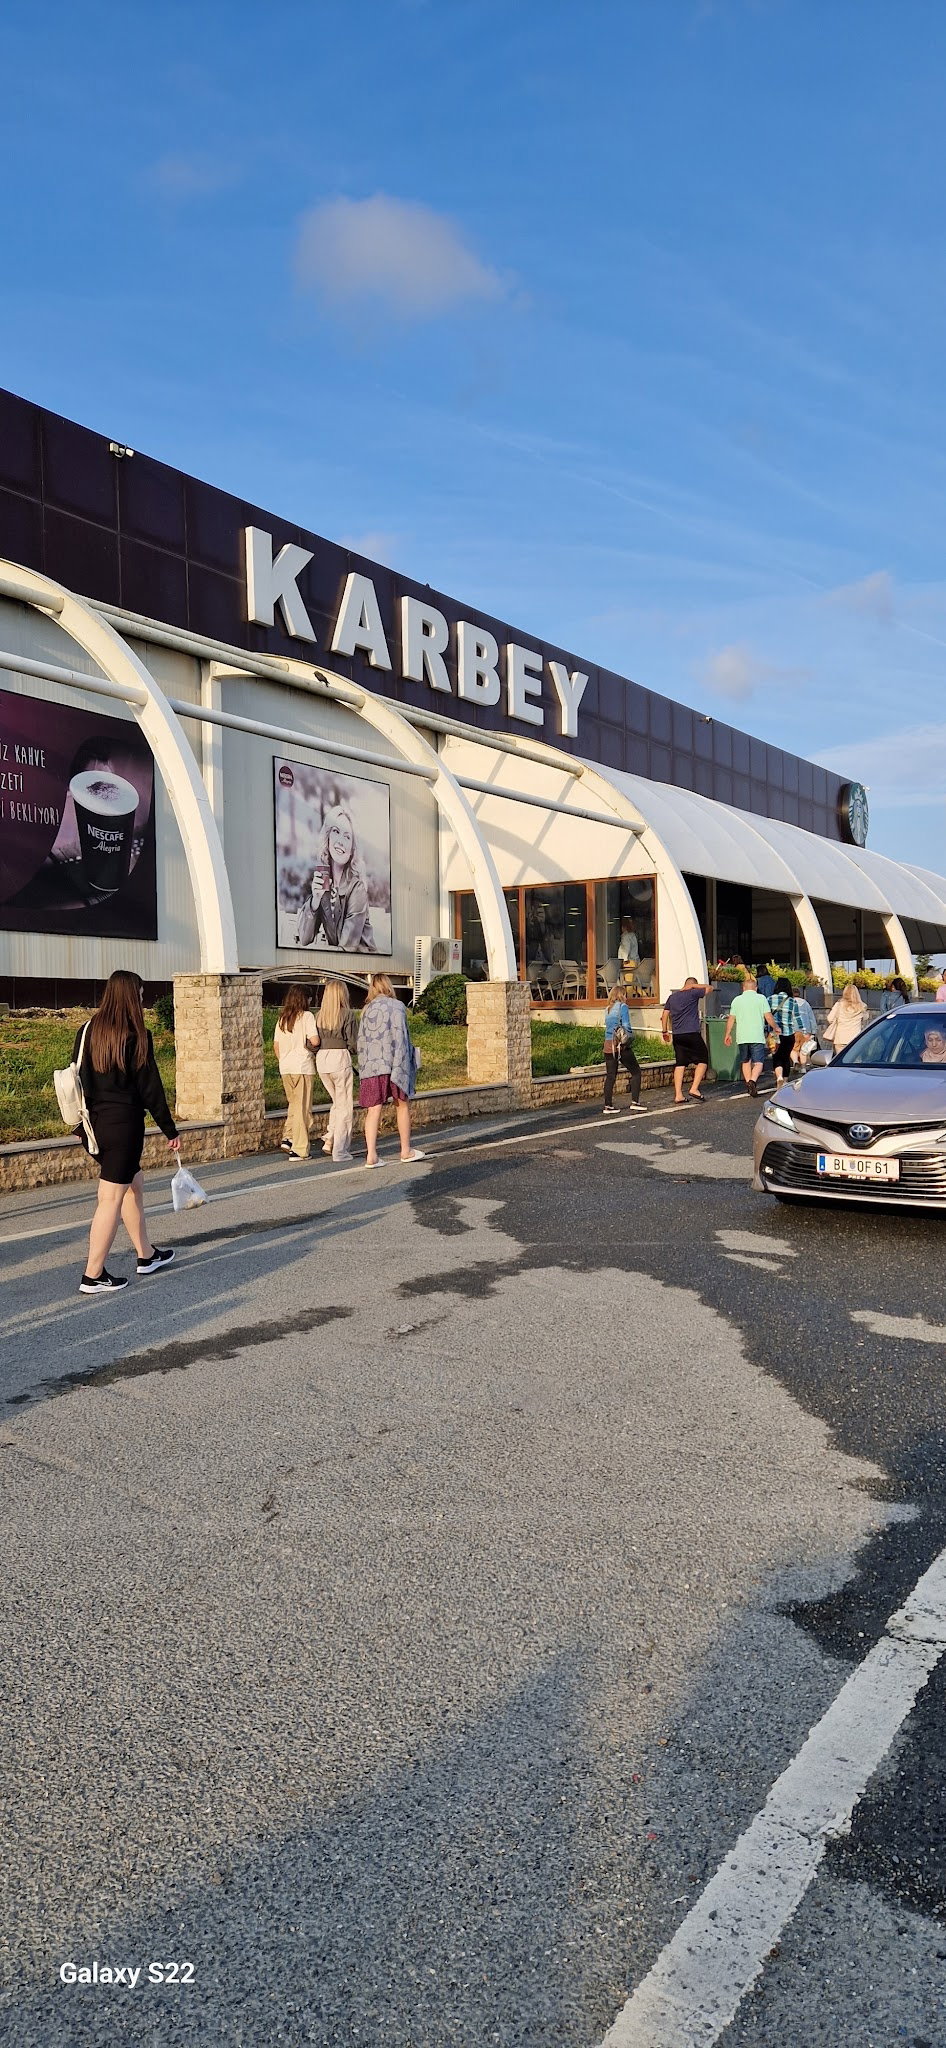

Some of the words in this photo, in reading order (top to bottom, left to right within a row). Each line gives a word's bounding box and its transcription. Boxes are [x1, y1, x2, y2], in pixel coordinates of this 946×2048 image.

[245, 525, 589, 738] KARBEY
[14, 744, 46, 768] KAHVE
[10, 800, 60, 826] BEKLİYOR!
[92, 840, 121, 853] Alegria
[834, 1159, 847, 1171] BL
[875, 1162, 888, 1174] 61
